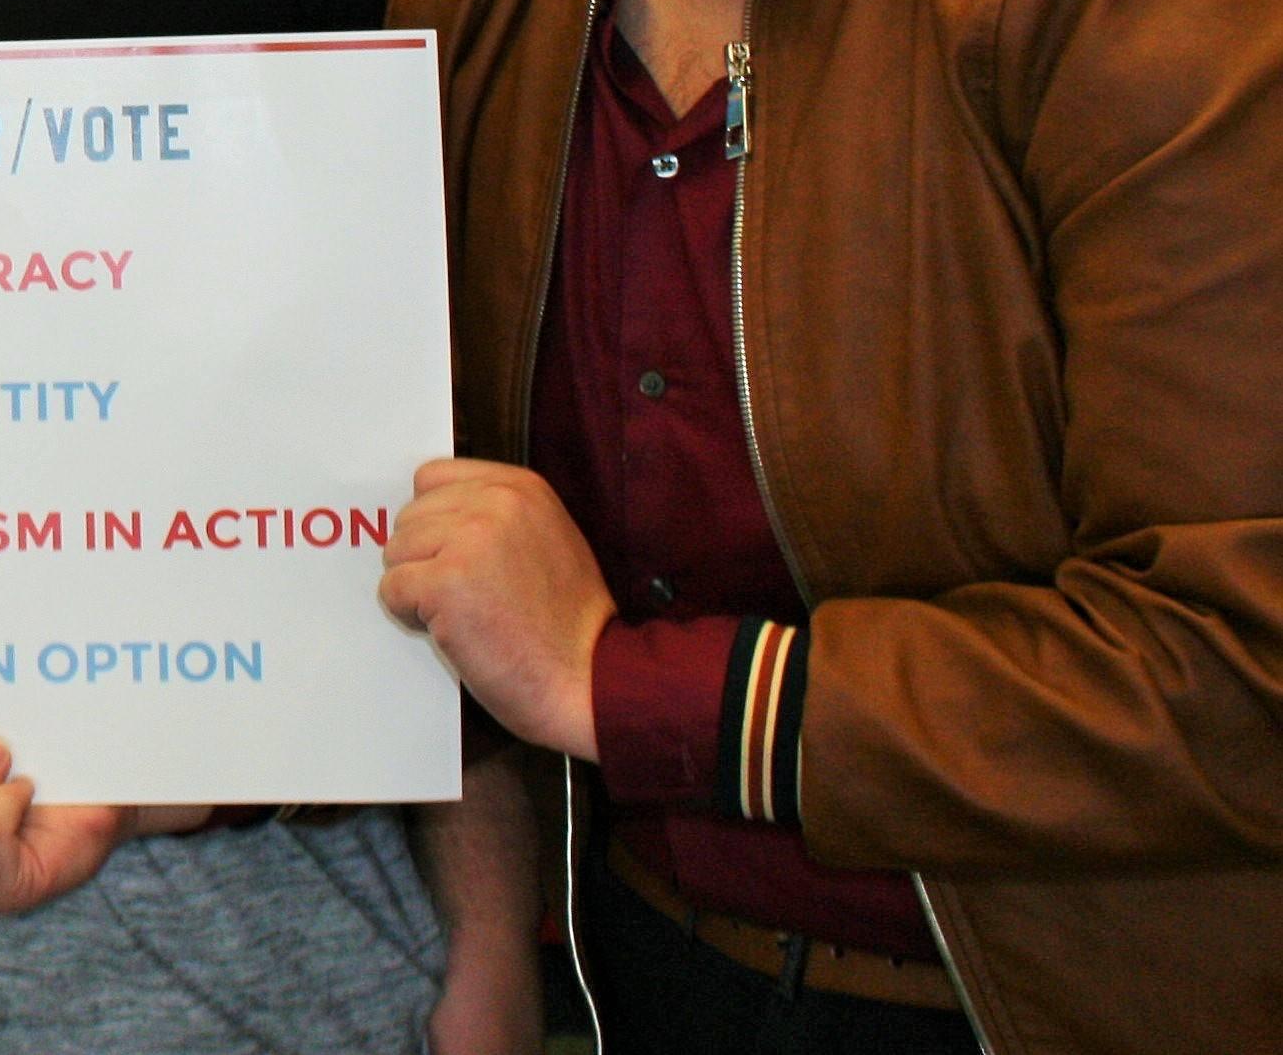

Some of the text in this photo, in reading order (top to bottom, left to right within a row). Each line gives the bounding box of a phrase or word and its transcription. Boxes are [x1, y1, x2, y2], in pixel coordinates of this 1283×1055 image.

[86, 511, 141, 550] IN
[164, 507, 388, 550] ACTION
[38, 641, 262, 682] OPTION
